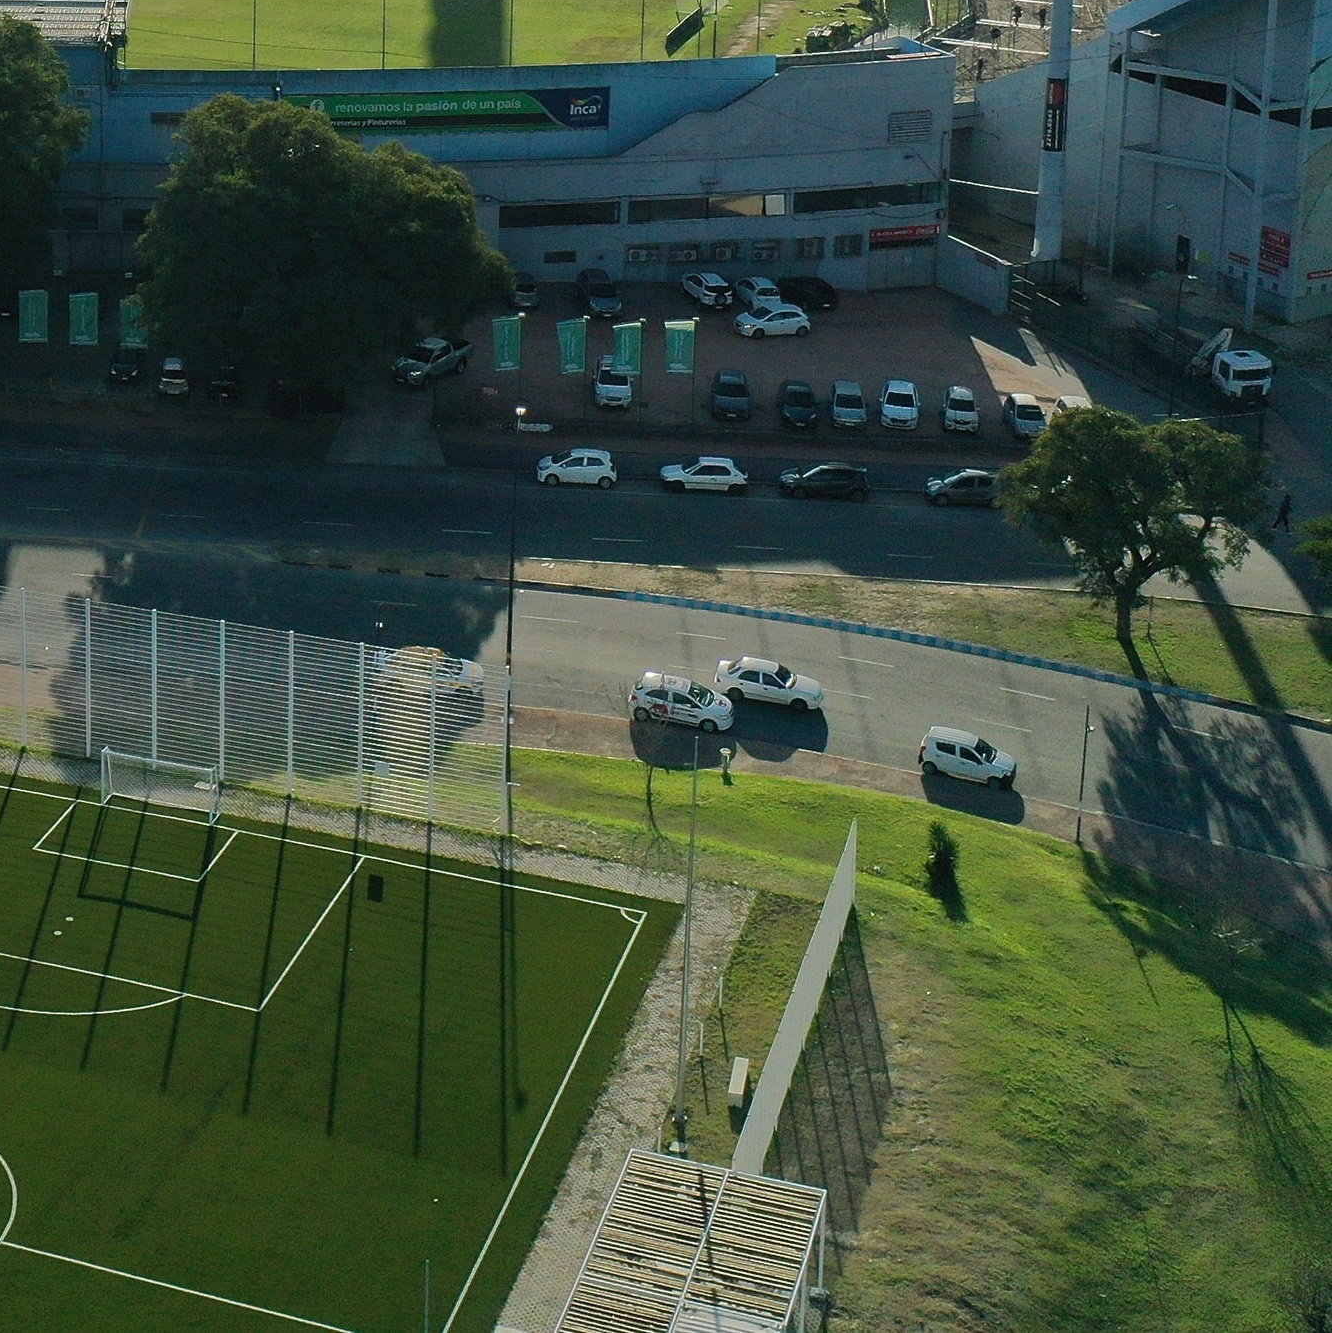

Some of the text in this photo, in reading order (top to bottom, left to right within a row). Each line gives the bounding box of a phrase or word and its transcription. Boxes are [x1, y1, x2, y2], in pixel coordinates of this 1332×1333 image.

[335, 98, 521, 113] renovamos la pasión de un país
[570, 104, 597, 115] Inca
[330, 118, 360, 127] rreterías
